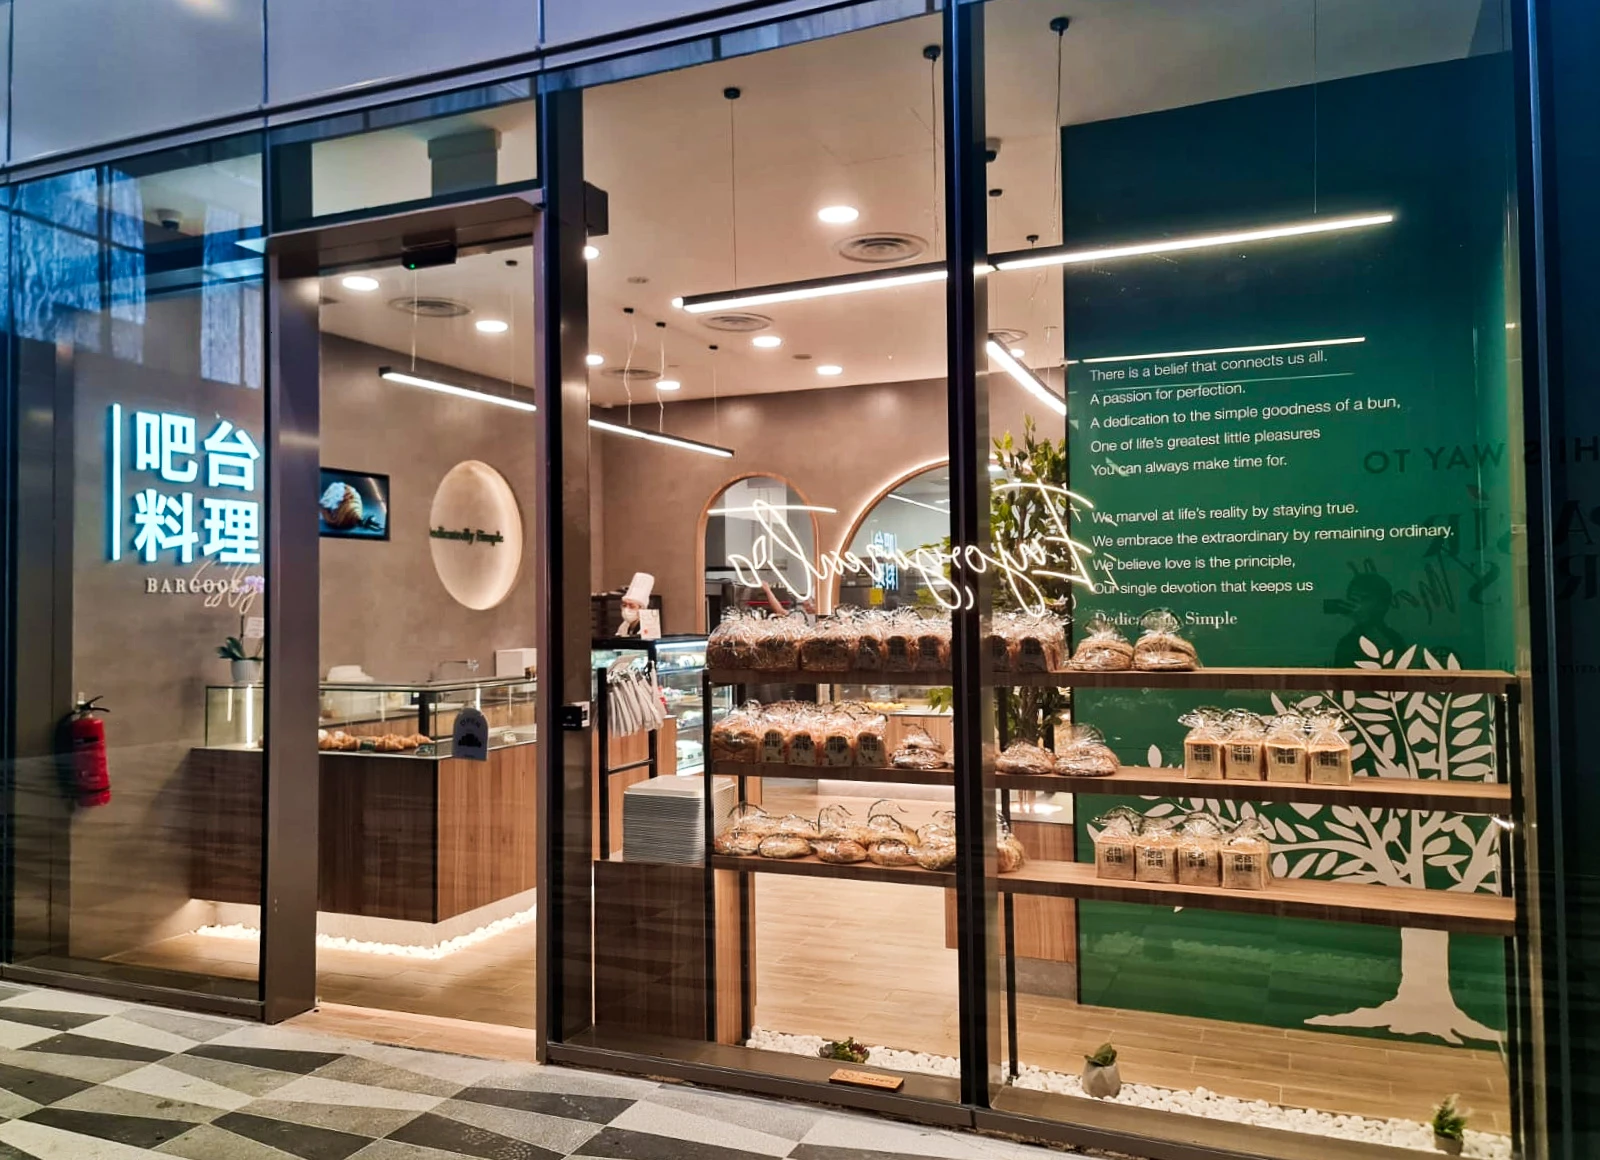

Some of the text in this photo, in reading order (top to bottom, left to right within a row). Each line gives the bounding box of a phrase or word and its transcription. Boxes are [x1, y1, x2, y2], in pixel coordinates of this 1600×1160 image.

[1090, 350, 1328, 381] There is a belief that connects us all.
[1089, 384, 1246, 406] A passion for perfection.
[1090, 397, 1401, 429] A dedication to the simple goodness of a bun,
[135, 411, 261, 492] 吧台
[1090, 428, 1321, 453] One of life's greatest little pleasures
[1091, 454, 1287, 476] You can always make time for.
[1091, 502, 1359, 523] We marvel at life's reality by staying true.
[134, 488, 261, 564] 料理
[1092, 524, 1455, 547] We embrace the extraordinary by remaining ordinary.
[1093, 554, 1296, 571] We believe love is the principle,
[1094, 579, 1314, 596] Our single devotion that keeps us
[1185, 610, 1238, 629] Simple
